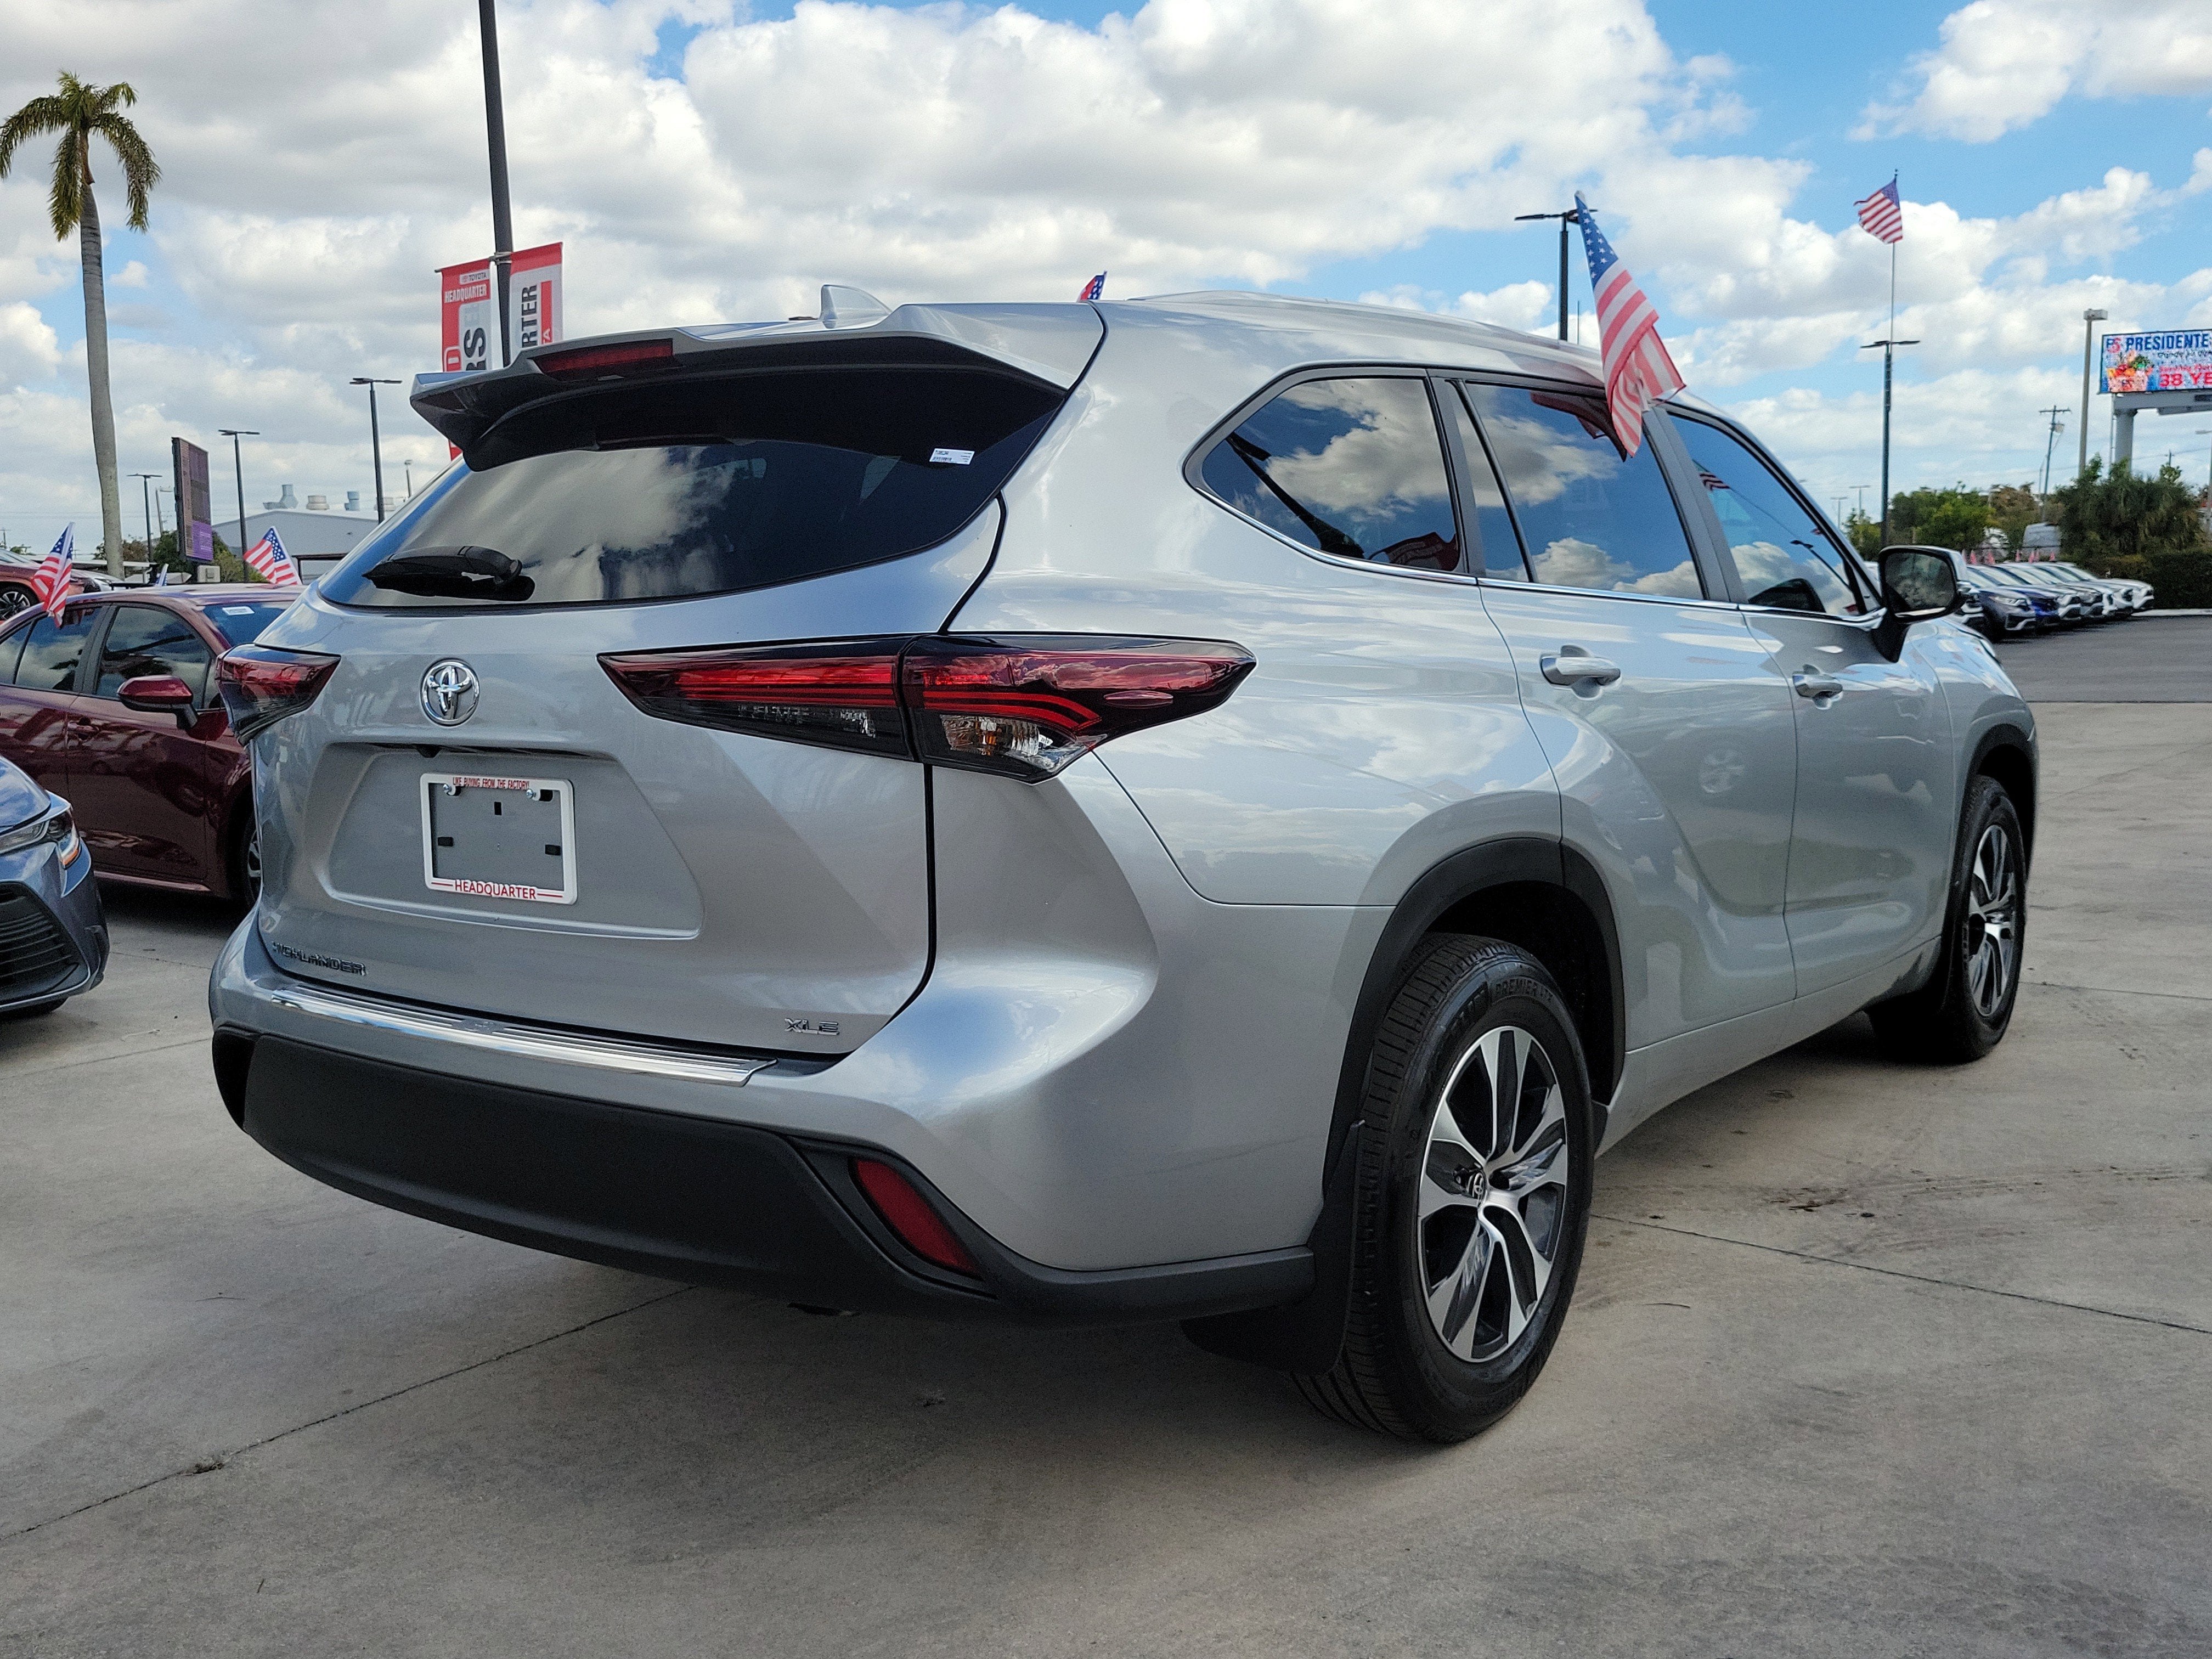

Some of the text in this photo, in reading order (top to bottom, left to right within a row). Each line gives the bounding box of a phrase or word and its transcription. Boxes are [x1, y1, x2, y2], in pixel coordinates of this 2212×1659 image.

[469, 272, 487, 281] TOYOTA
[444, 284, 487, 302] HEADQUARTER
[2126, 334, 2209, 352] PRESIDENTE
[2159, 374, 2182, 387] 38
[482, 778, 495, 788] FROM
[497, 779, 506, 788] THE
[455, 879, 537, 900] HEADQUARTER
[784, 1018, 840, 1036] XLE
